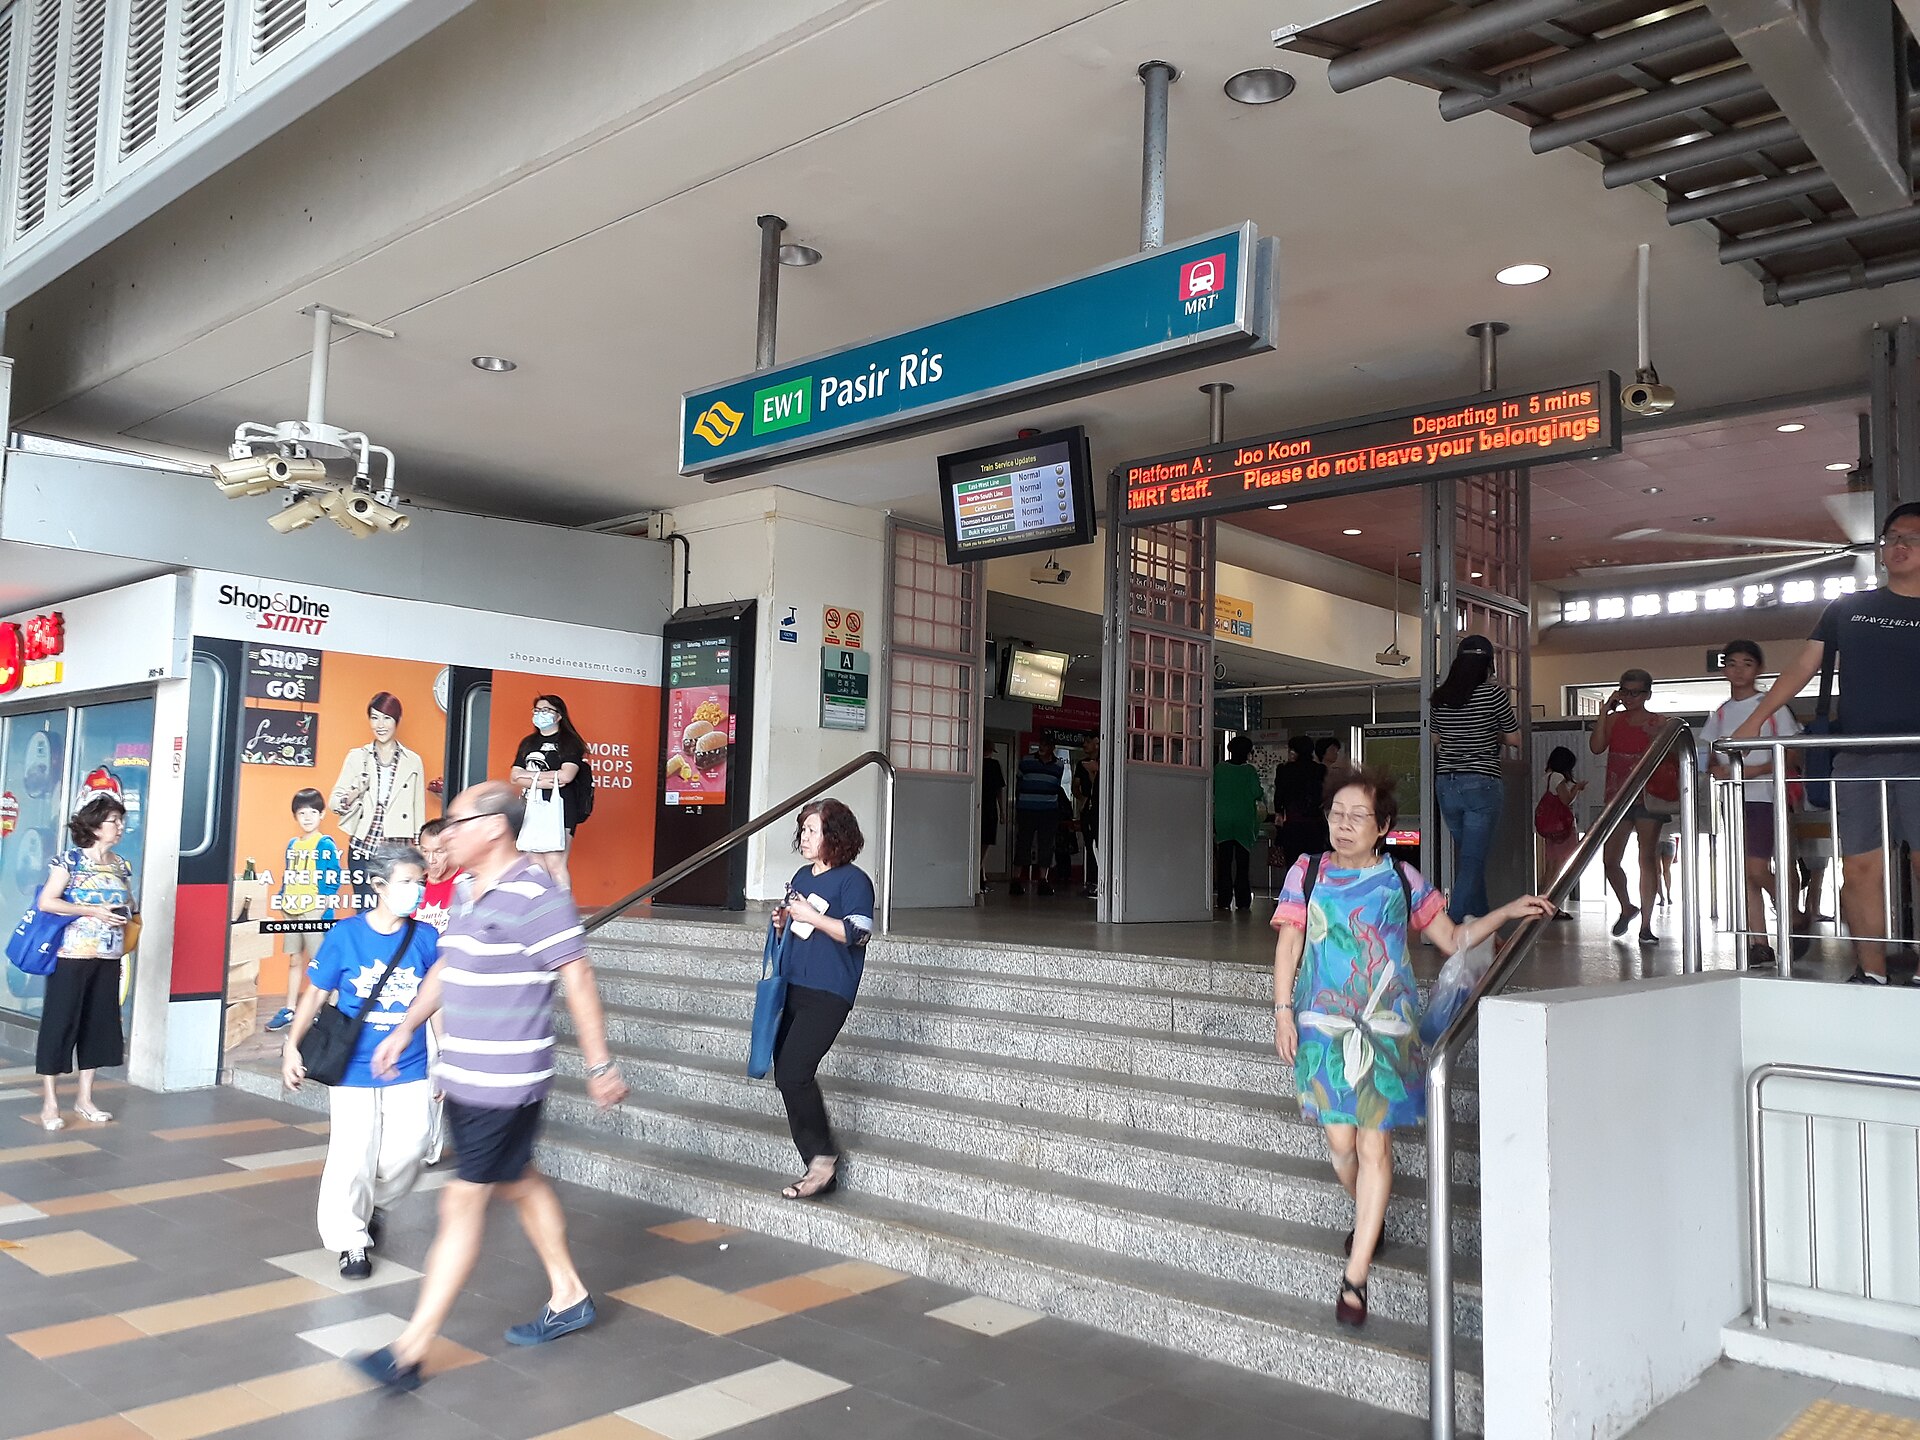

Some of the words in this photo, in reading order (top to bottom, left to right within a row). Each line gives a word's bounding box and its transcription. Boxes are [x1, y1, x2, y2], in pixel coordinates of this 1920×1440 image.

[1184, 293, 1216, 316] MRT
[763, 389, 804, 423] EW1
[820, 363, 889, 412] Pasir
[899, 348, 943, 390] Ris
[1128, 462, 1187, 486] Platform
[1234, 449, 1263, 467] Joo
[1268, 440, 1311, 461] Koon
[1413, 407, 1496, 435] Departing
[1502, 401, 1519, 419] in
[1529, 396, 1540, 414] 5
[1545, 390, 1592, 411] mins
[981, 463, 994, 473] Train
[994, 461, 1014, 470] Service
[1014, 455, 1036, 466] Updates
[1171, 478, 1212, 503] staff.
[1243, 467, 1303, 490] Please
[1306, 458, 1330, 479] do
[1335, 452, 1366, 475] not
[1369, 447, 1422, 470] leave
[1426, 436, 1474, 465] your
[1479, 415, 1599, 451] belongings
[968, 481, 989, 491] East-West
[989, 479, 1000, 488] Line
[1018, 470, 1041, 481] Normal
[993, 490, 1004, 498] Line
[1019, 482, 1042, 493] Normal
[974, 505, 988, 513] Circle
[989, 503, 998, 511] Line
[1020, 494, 1043, 505] Normal
[991, 513, 1003, 522] Coast
[1004, 511, 1014, 519] Line
[1022, 506, 1044, 516] Normal
[999, 523, 1008, 531] LRT
[1023, 517, 1045, 528] Normal
[256, 612, 328, 635] SMRT
[258, 648, 309, 671] SHOP
[510, 651, 647, 678] shopanddineatsmrt.com.sg
[842, 653, 852, 668] A
[266, 680, 300, 699] GO
[586, 742, 630, 757] MORE
[590, 775, 633, 789] HEAD
[286, 849, 345, 860] EVERY
[259, 869, 275, 885] A
